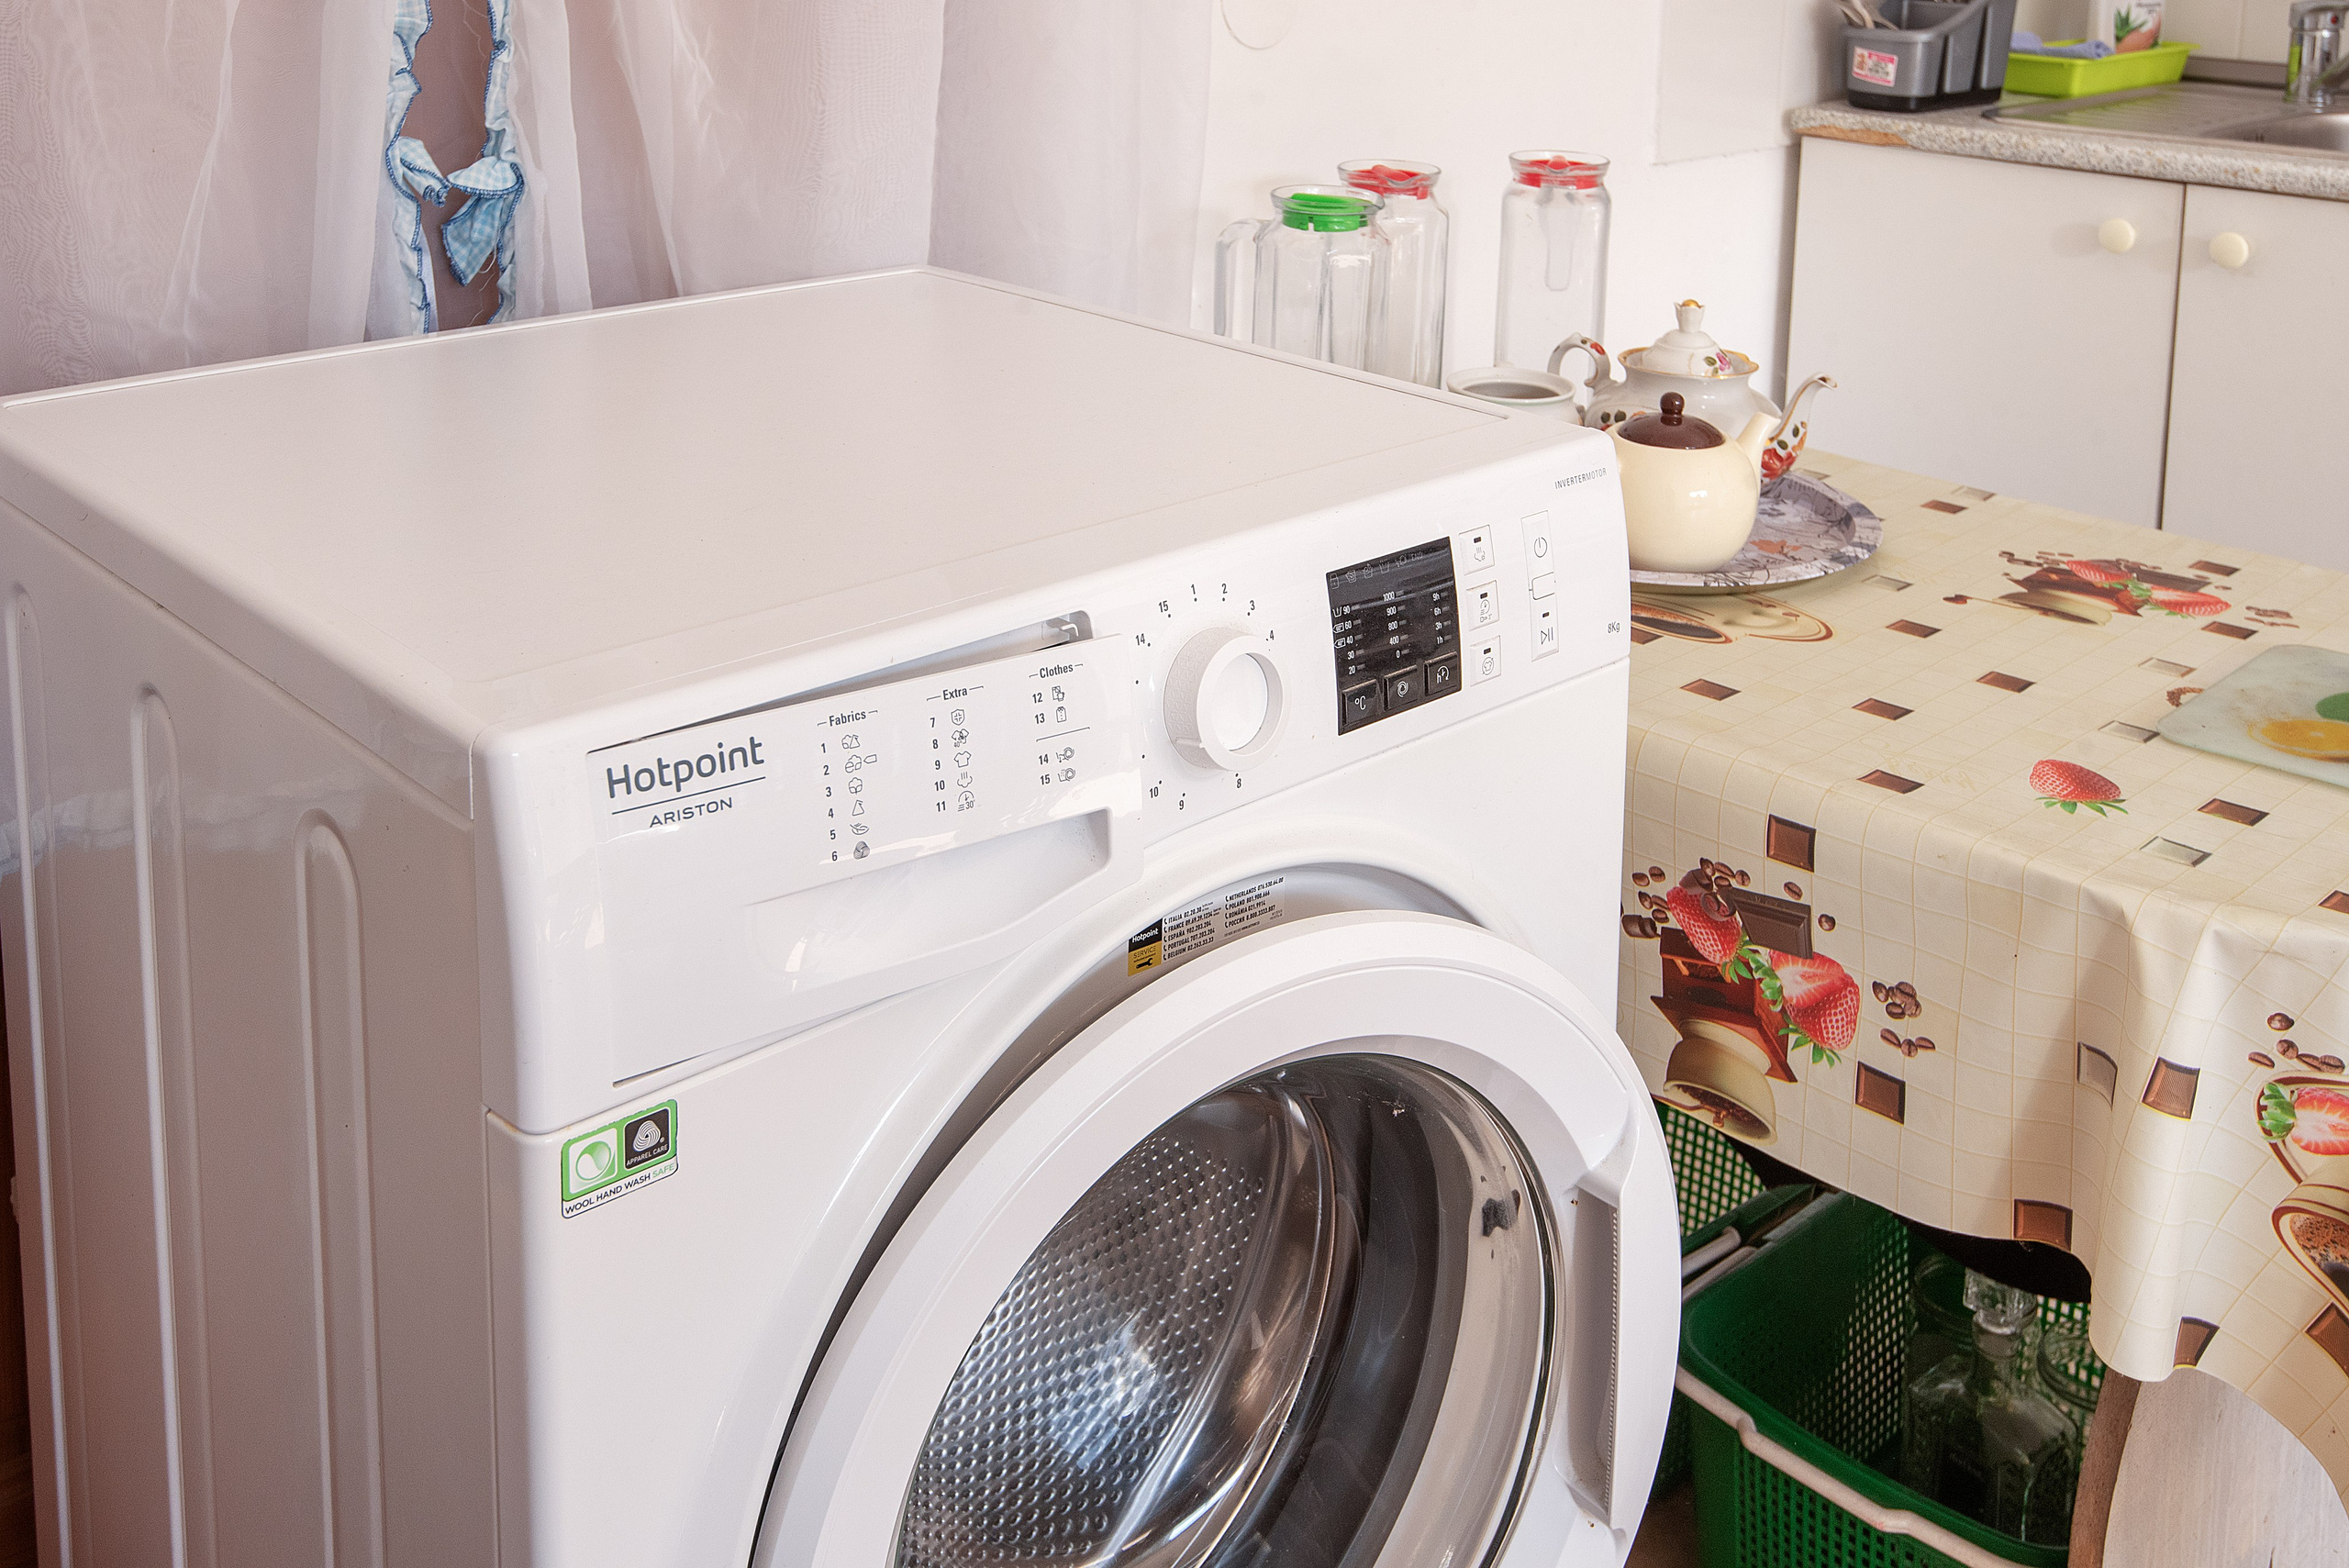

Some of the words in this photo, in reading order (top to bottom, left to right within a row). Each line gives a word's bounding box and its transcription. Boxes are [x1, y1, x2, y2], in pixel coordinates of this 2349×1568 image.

[1554, 467, 1607, 489] INVERTERMOTOR
[1191, 584, 1197, 595] 1
[1221, 583, 1228, 594] 2
[1383, 591, 1395, 602] 1000
[1432, 593, 1441, 602] 9h
[1158, 600, 1169, 613] 15
[1250, 600, 1255, 611] 3
[1342, 606, 1351, 615] 90
[1386, 606, 1397, 616] 900
[1434, 607, 1442, 616] 6h
[1345, 620, 1353, 629] 60
[1388, 621, 1397, 630] 800
[1608, 621, 1620, 633] 8Kg
[1135, 633, 1145, 646] 14
[1269, 629, 1275, 640] 4
[1346, 636, 1353, 644] 40
[1389, 636, 1399, 646] 400
[1347, 650, 1355, 660] 30
[1396, 650, 1400, 659] 0
[1040, 663, 1074, 678] Clothes
[1349, 665, 1356, 675] 20
[942, 688, 968, 700] Extra
[1032, 692, 1043, 704] 12
[1354, 695, 1366, 710] °C
[829, 710, 866, 728] Fabrics
[930, 717, 936, 728] 7
[1035, 713, 1045, 724] 13
[821, 743, 826, 753] 1
[932, 739, 939, 749] 8
[935, 760, 941, 770] 9
[1039, 754, 1049, 765] 14
[607, 736, 764, 798] Hotpoint
[823, 764, 829, 775] 2
[1040, 774, 1051, 785] 15
[1236, 778, 1241, 788] 8
[934, 780, 945, 791] 10
[826, 786, 832, 797] 3
[1149, 786, 1159, 798] 10
[936, 801, 946, 812] 11
[1179, 799, 1185, 810] 9
[650, 797, 732, 828] ARISTON
[828, 807, 834, 818] 4
[829, 829, 836, 840] 5
[831, 851, 838, 862] 6
[1230, 886, 1256, 901] NETHERLANDS
[1229, 899, 1245, 909] POLAND
[1168, 914, 1183, 923] ITALIA
[1184, 906, 1202, 917] 02.20.30
[1168, 921, 1184, 932] FRANCE
[1131, 928, 1159, 943] Hotpoint
[1168, 929, 1185, 941] ESPAÑA
[1168, 937, 1190, 950] PORTUGAL
[1133, 946, 1156, 958] SERVICE
[1168, 947, 1186, 959] BELGIUM
[627, 1150, 652, 1166] APPAREL
[653, 1144, 668, 1155] CARE
[565, 1197, 595, 1214] WOOL
[596, 1185, 622, 1202] HAND
[624, 1173, 651, 1189] WASH
[652, 1162, 674, 1178] SAFE
